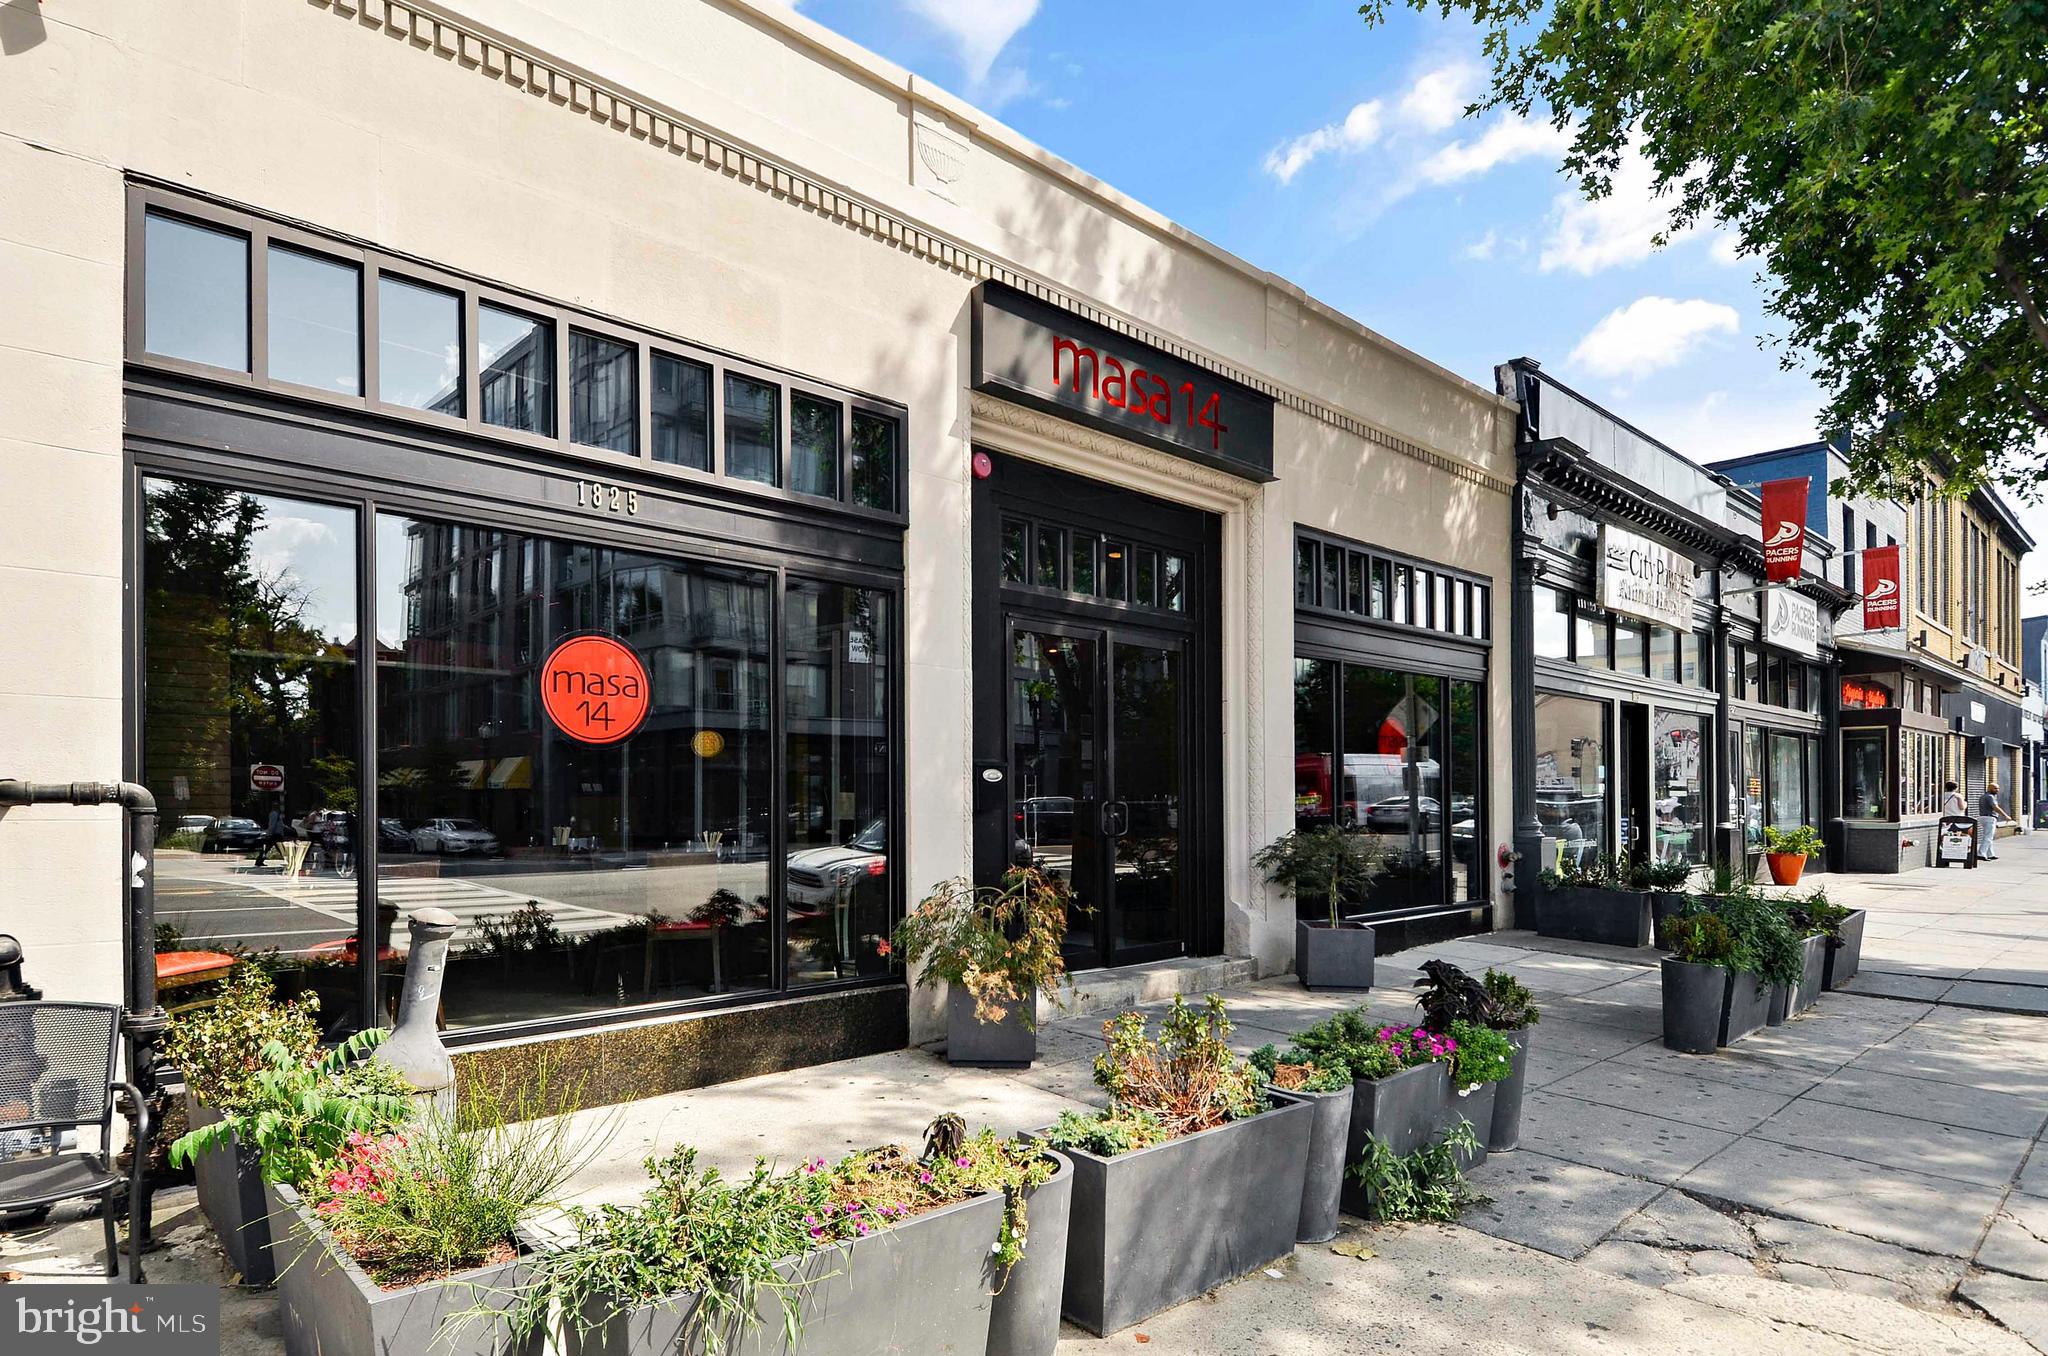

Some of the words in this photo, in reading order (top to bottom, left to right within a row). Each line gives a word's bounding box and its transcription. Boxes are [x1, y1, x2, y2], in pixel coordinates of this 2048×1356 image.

[1052, 335, 1171, 425] masa
[1178, 381, 1228, 449] 14
[577, 480, 638, 515] 1825
[1766, 546, 1799, 557] PACERS
[1766, 555, 1798, 563] RUNNING
[1629, 549, 1656, 587] City
[1791, 601, 1815, 627] PACERS
[1867, 598, 1898, 607] PACERS
[1867, 604, 1897, 613] RUNNING
[1791, 622, 1815, 642] RUNNING
[553, 670, 639, 698] masa
[576, 700, 616, 731] 14
